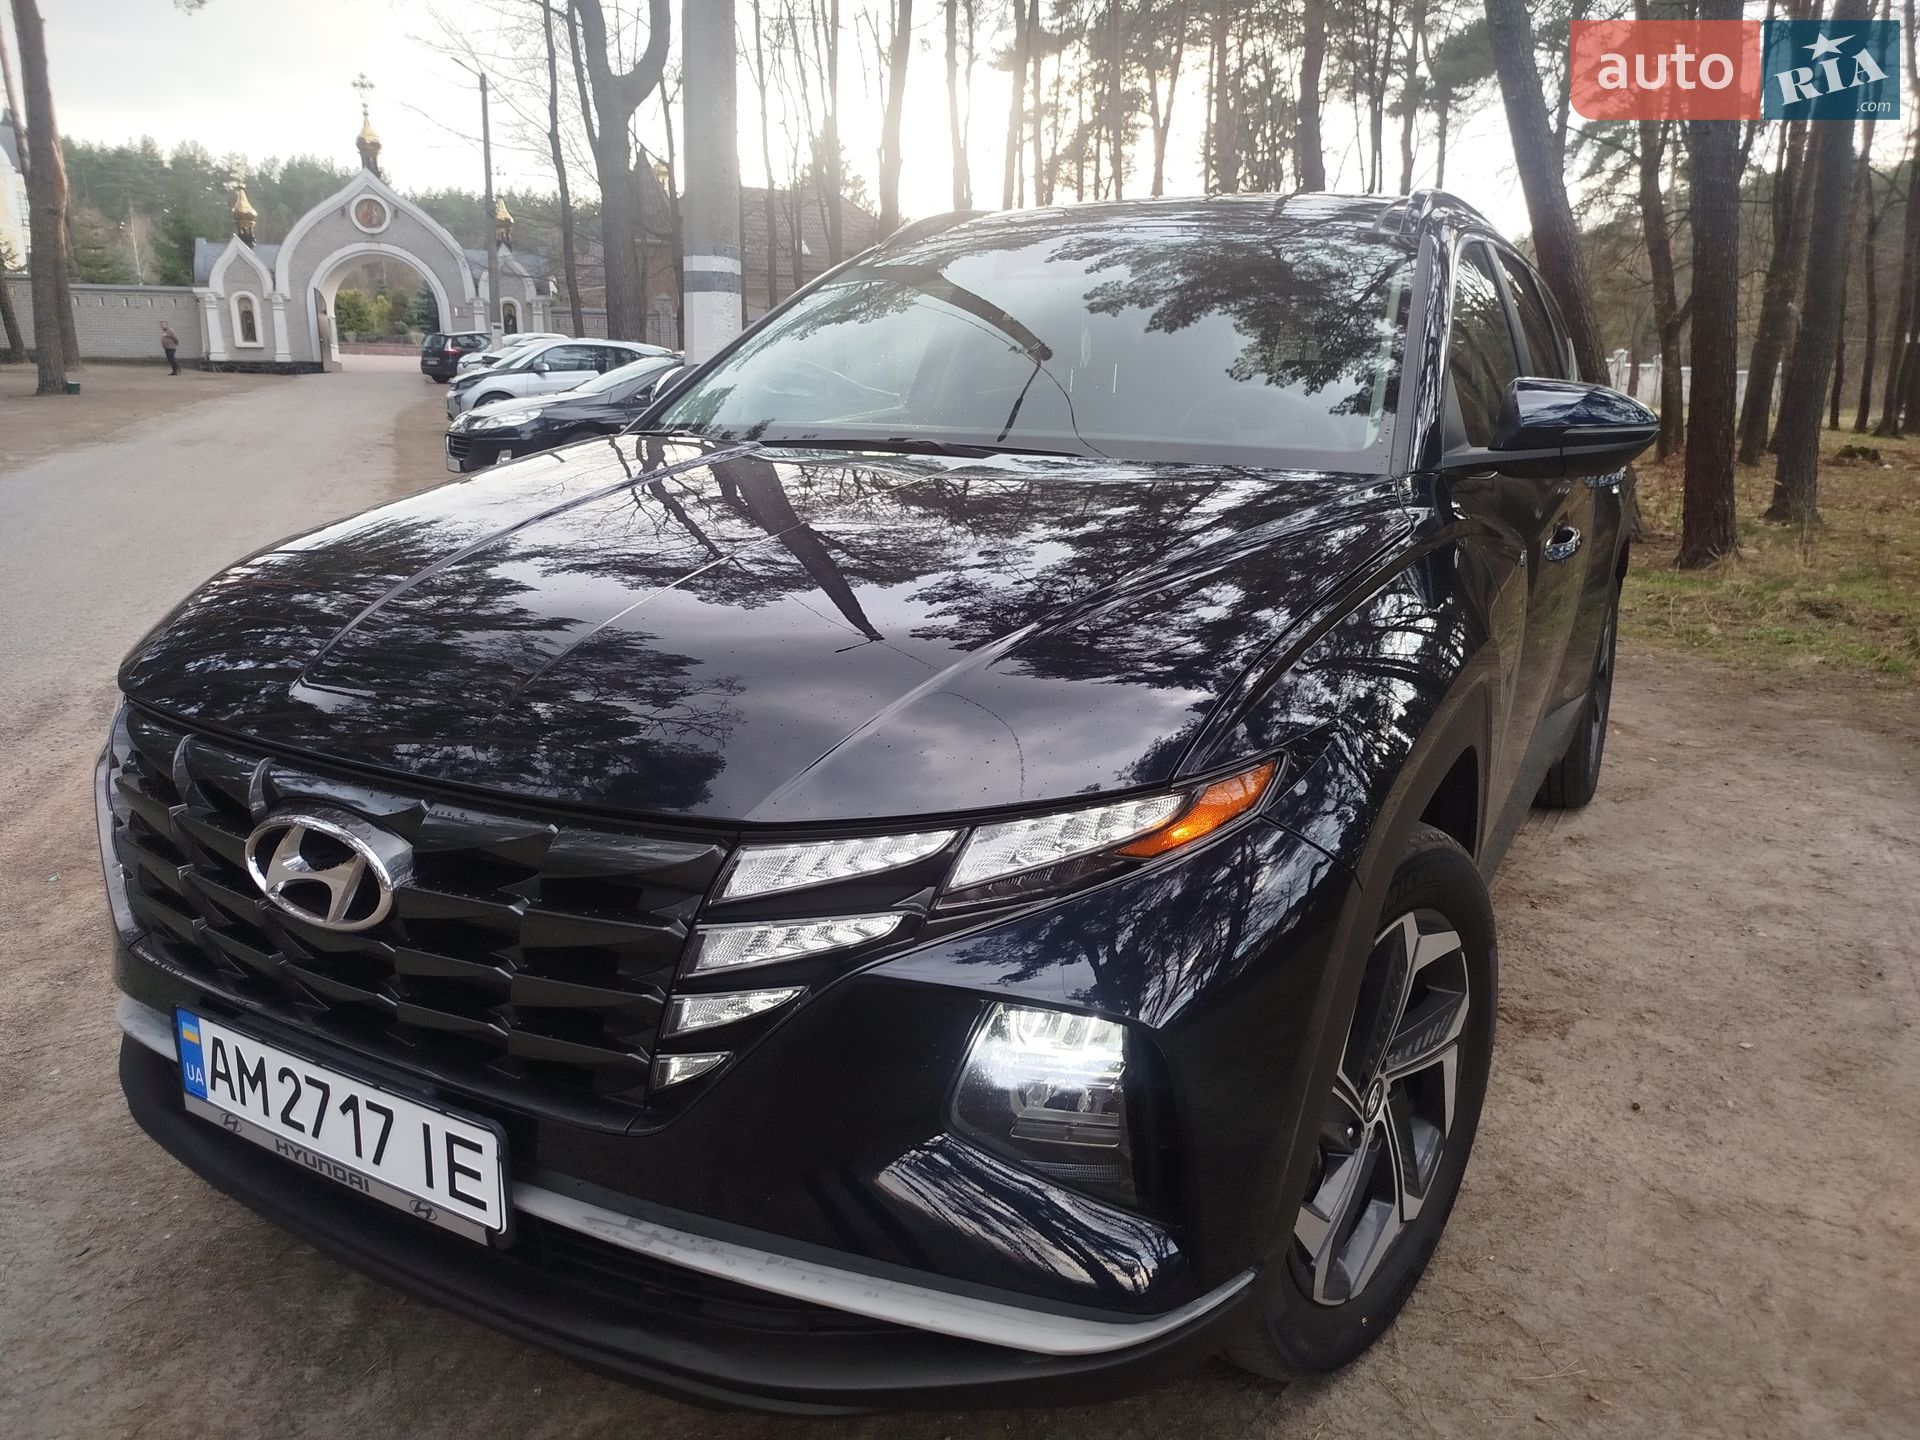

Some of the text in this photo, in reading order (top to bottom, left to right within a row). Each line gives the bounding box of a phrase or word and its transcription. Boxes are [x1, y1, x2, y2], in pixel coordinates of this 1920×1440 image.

[187, 1063, 205, 1087] UA
[275, 1138, 370, 1193] HYUNDAI
[422, 1121, 488, 1212] IE
